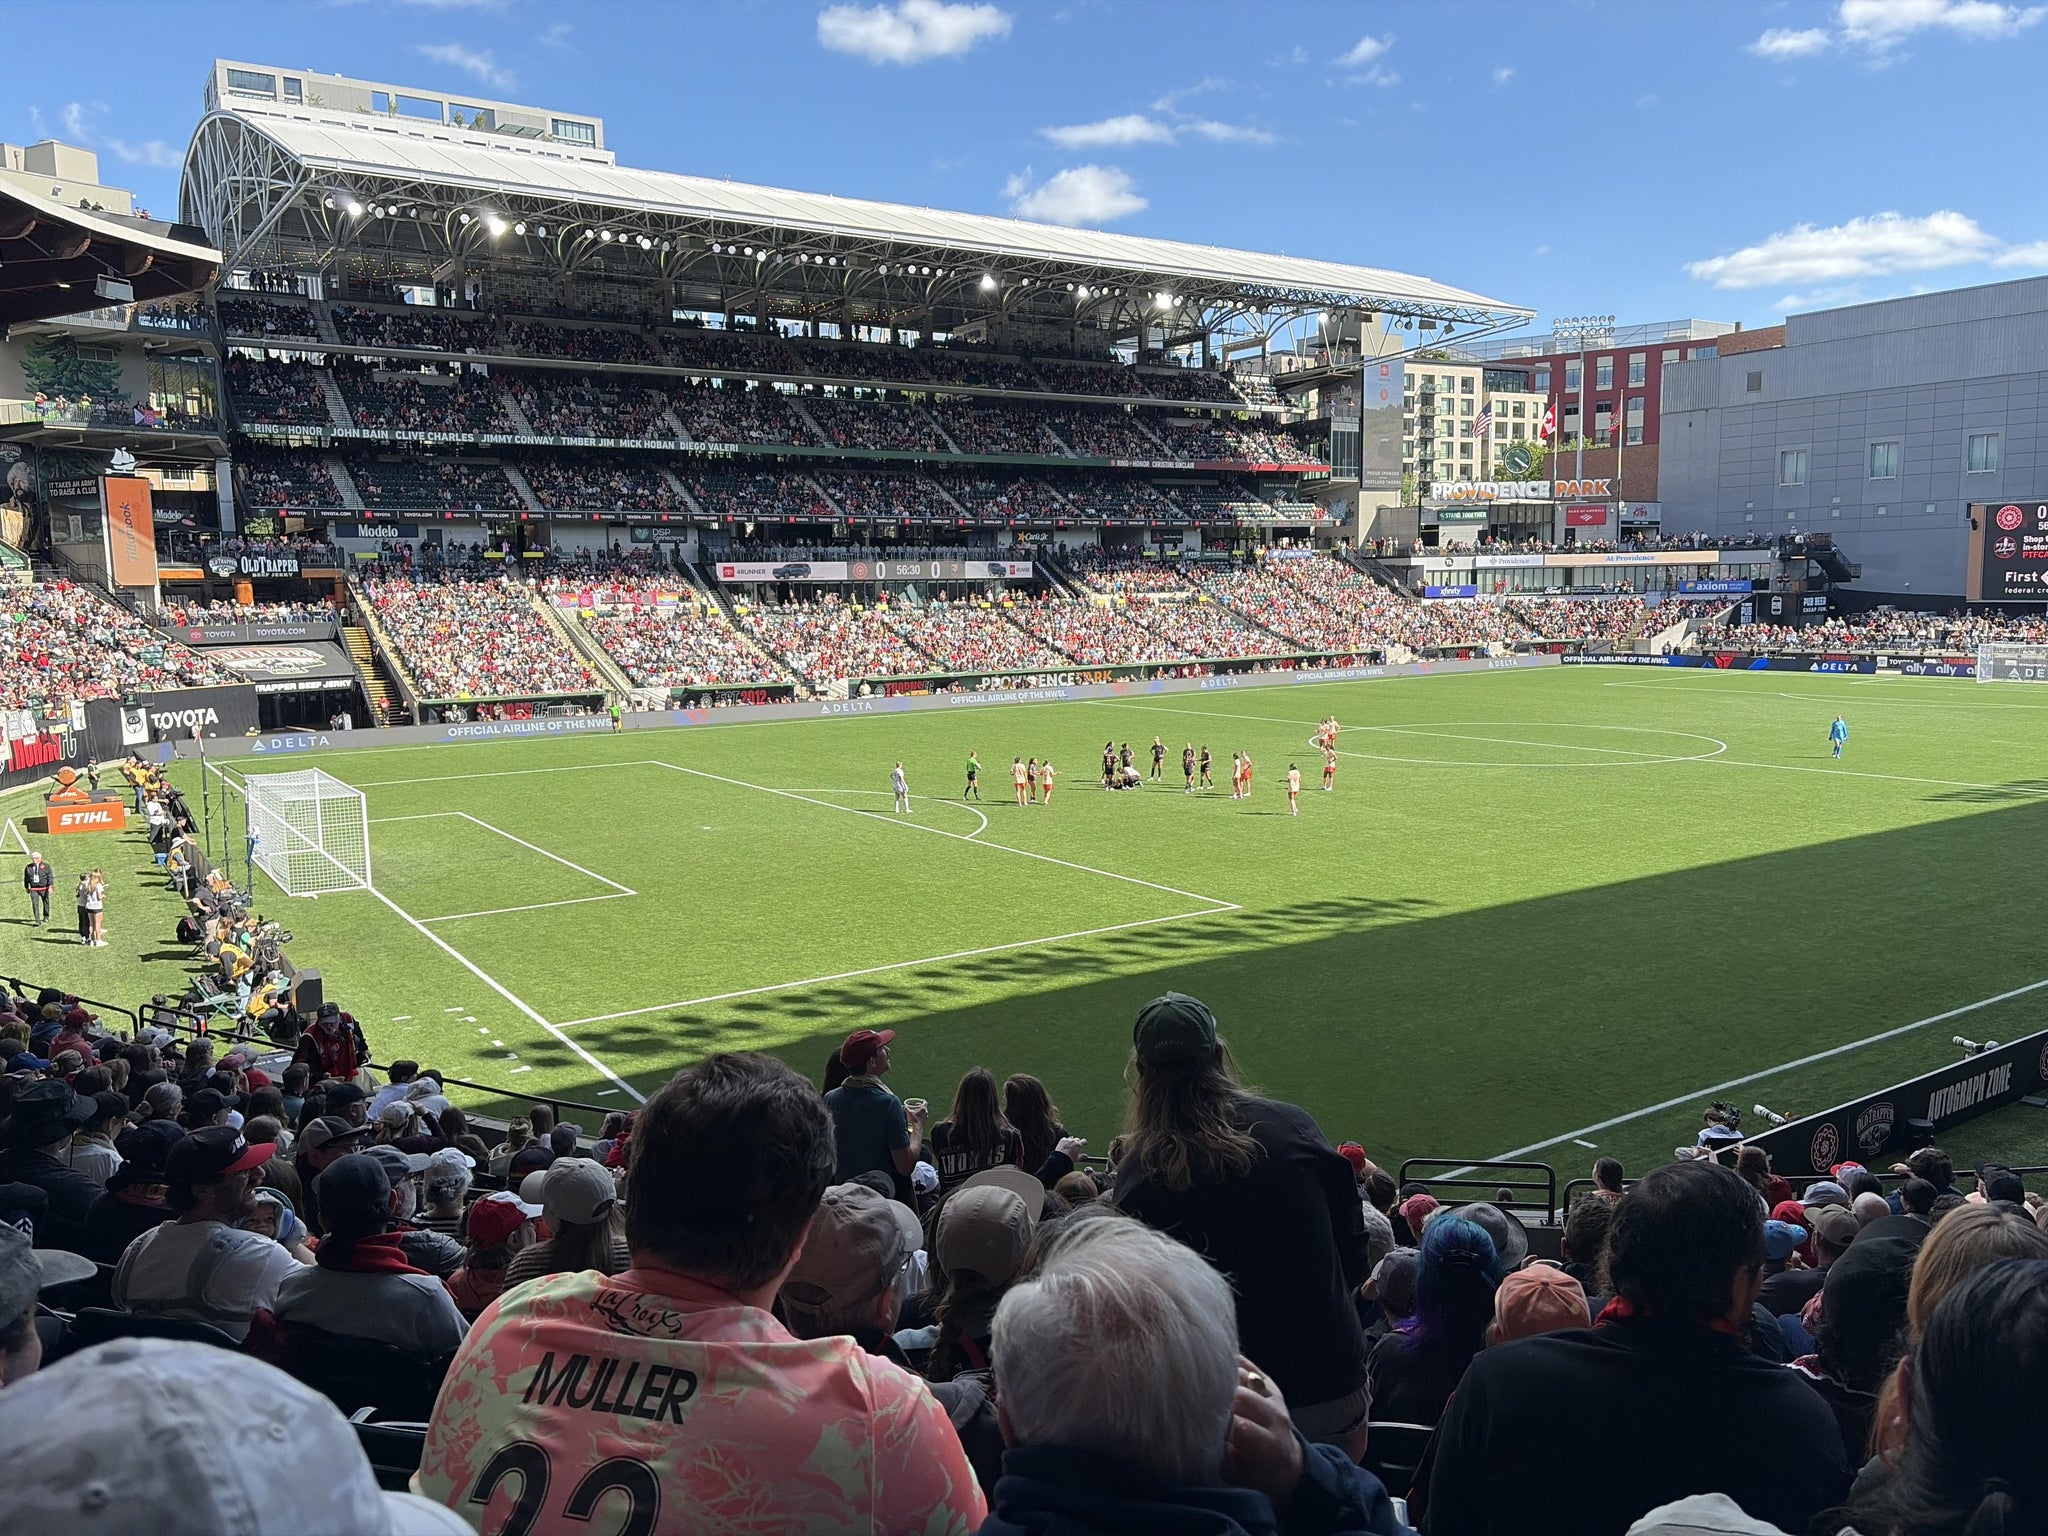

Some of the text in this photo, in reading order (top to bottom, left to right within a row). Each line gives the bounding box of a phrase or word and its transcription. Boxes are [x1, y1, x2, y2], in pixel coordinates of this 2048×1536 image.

[254, 423, 279, 434] RING
[287, 425, 323, 436] HONOR
[330, 427, 389, 439] JOHN BAIN
[395, 430, 474, 443] CLIVE CHARLES
[480, 433, 554, 445] JIMMY CONWAY
[560, 436, 615, 448] TIMBER JIM
[619, 438, 675, 450] MICK HOBAN
[679, 441, 739, 452] DIEGO VALERI
[1152, 460, 1175, 469] CHRISTINE
[1175, 461, 1195, 469] SINCLAIR
[55, 481, 72, 489] TAKES
[72, 480, 80, 488] AN
[81, 479, 96, 487] ARMY
[1431, 478, 1612, 500] PROVIDENCE PARK
[50, 489, 58, 497] TO
[59, 487, 76, 496] RAISE
[82, 486, 97, 495] CLUB
[156, 509, 182, 520] Modelo
[2037, 505, 2047, 519] 0
[358, 523, 399, 538] Modelo
[652, 528, 671, 536] DSP
[2023, 535, 2044, 544] Shop
[1498, 557, 1530, 565] Providence
[1615, 554, 1656, 562] Providence
[241, 556, 299, 573] OLD TRAPPER
[876, 561, 941, 579] 0 56:30 0
[736, 568, 767, 576] 4RUNNER
[2005, 571, 2038, 582] First
[1440, 586, 1462, 596] xfinity
[1544, 586, 1562, 595] Ford
[1696, 581, 1728, 591] axiom
[1803, 596, 1827, 607] PUB BEER
[205, 628, 306, 638] TOYOTA TOYOTA.COM
[1495, 659, 1518, 667] DELTA
[1563, 655, 1597, 663] OFFICIAL
[1598, 655, 1628, 663] AIRLINE
[1637, 656, 1650, 664] THE
[1821, 662, 1858, 672] DELTA
[1906, 663, 1927, 675] ally
[1935, 664, 1957, 676] ally
[1296, 671, 1323, 680] OFFICIAL
[1324, 670, 1347, 679] AIRLINE
[255, 679, 352, 693] TRAPPER BEEF JERKY
[1209, 678, 1239, 687] DELTA
[740, 689, 767, 705] 2012
[950, 689, 1067, 705] OFFICIAL AIRLINE OF THE NWSL
[833, 701, 873, 712] DELTA
[151, 707, 219, 729] TOYOTA
[447, 718, 613, 737] OFFICIAL AIRLINE OF THE NWS
[271, 735, 330, 749] DELTA
[60, 811, 113, 826] STIHL
[1927, 1062, 2013, 1122] AUTOGRAPH ZONE
[523, 1351, 698, 1425] MULLER
